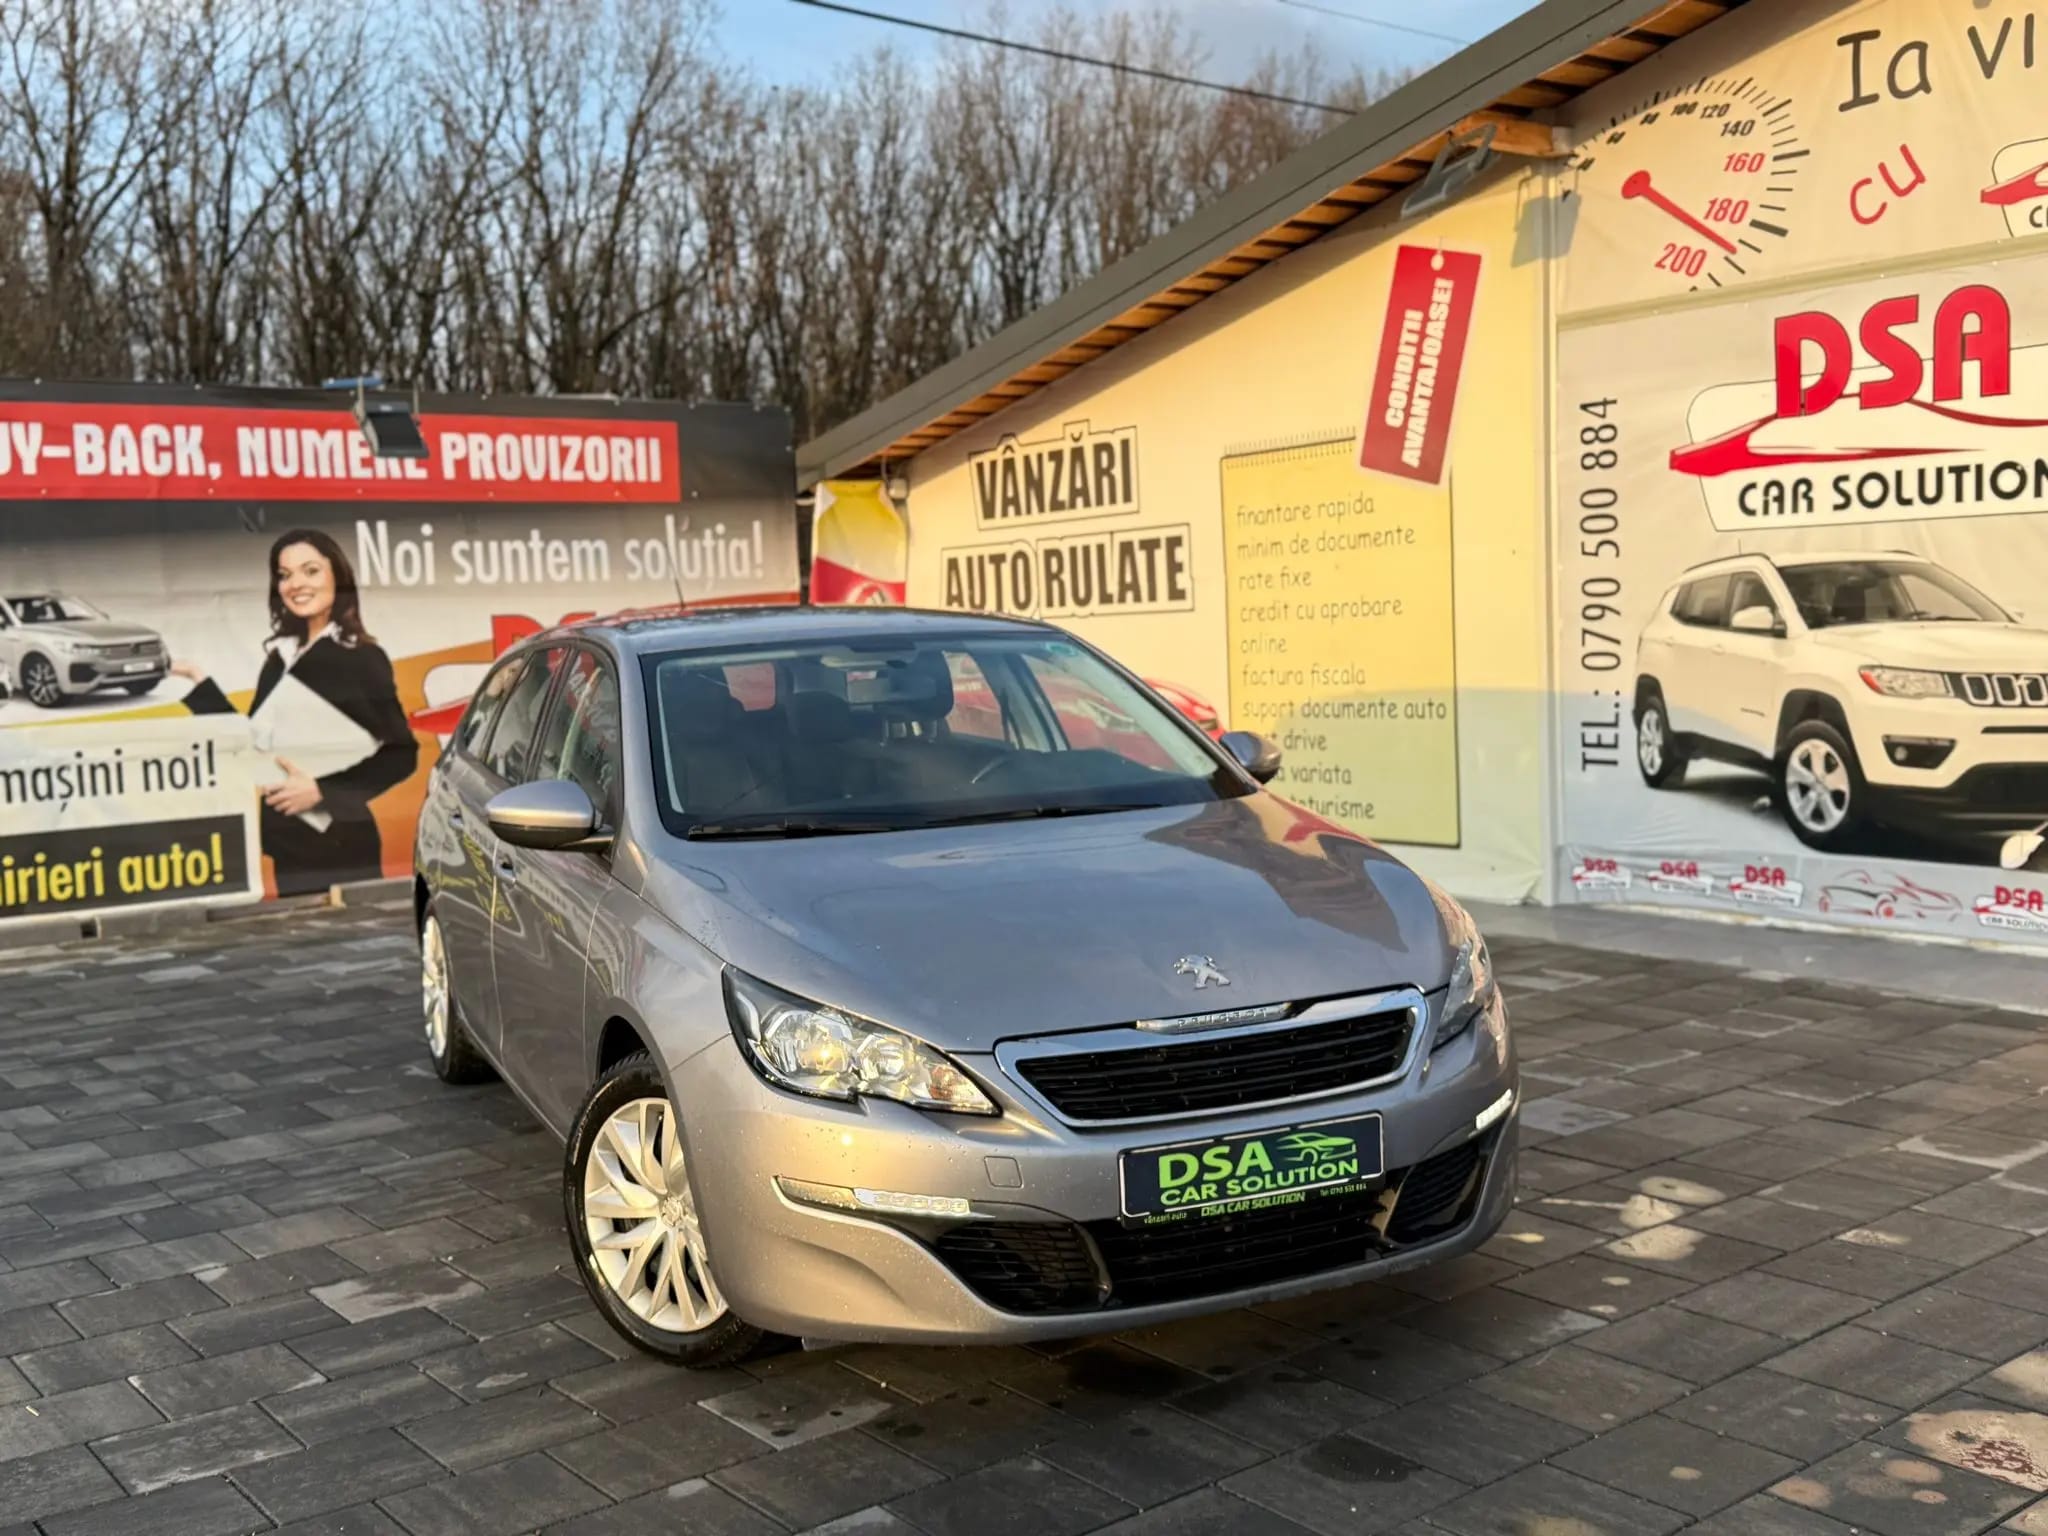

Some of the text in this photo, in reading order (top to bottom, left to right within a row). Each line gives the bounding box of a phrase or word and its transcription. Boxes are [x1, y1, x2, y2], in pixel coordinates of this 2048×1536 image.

[1837, 29, 1932, 112] Ia
[1700, 103, 1730, 119] 120
[1720, 119, 1755, 137] 140
[1723, 152, 1766, 173] 160
[1850, 144, 1926, 224] cu
[1704, 198, 1749, 224] 180
[1655, 242, 1707, 277] 200
[1774, 284, 2010, 419] DSA
[1580, 397, 1618, 470] 884
[440, 432, 662, 483] PROVIZORII
[976, 431, 1132, 520] VÂNZĂRI
[1237, 490, 1375, 526] finantare rapida
[1738, 477, 1814, 517] CAR
[1580, 488, 1620, 558] 500
[356, 520, 435, 586] Noi
[451, 528, 610, 584] suntem
[1237, 526, 1416, 558] minim de documente
[946, 536, 1187, 611] AUTO RULATE
[1239, 565, 1311, 590] rate fixe
[1240, 595, 1403, 625] credit cu aprobare
[1581, 577, 1621, 671] 0790
[1240, 632, 1288, 655] online
[1242, 663, 1366, 687] factura fiscala
[1242, 697, 1447, 724] suport documente auto
[1283, 729, 1328, 751] drive
[142, 739, 216, 792] noi!
[1290, 762, 1352, 785] variata
[0, 833, 224, 906] irieri auto!
[1744, 864, 1785, 887] DSA
[1995, 886, 2044, 912] DSA
[1158, 1141, 1273, 1188] DSA
[1160, 1159, 1358, 1206] CAR SOLUTION
[1201, 1191, 1306, 1217] DSA CAR SOLUTION
